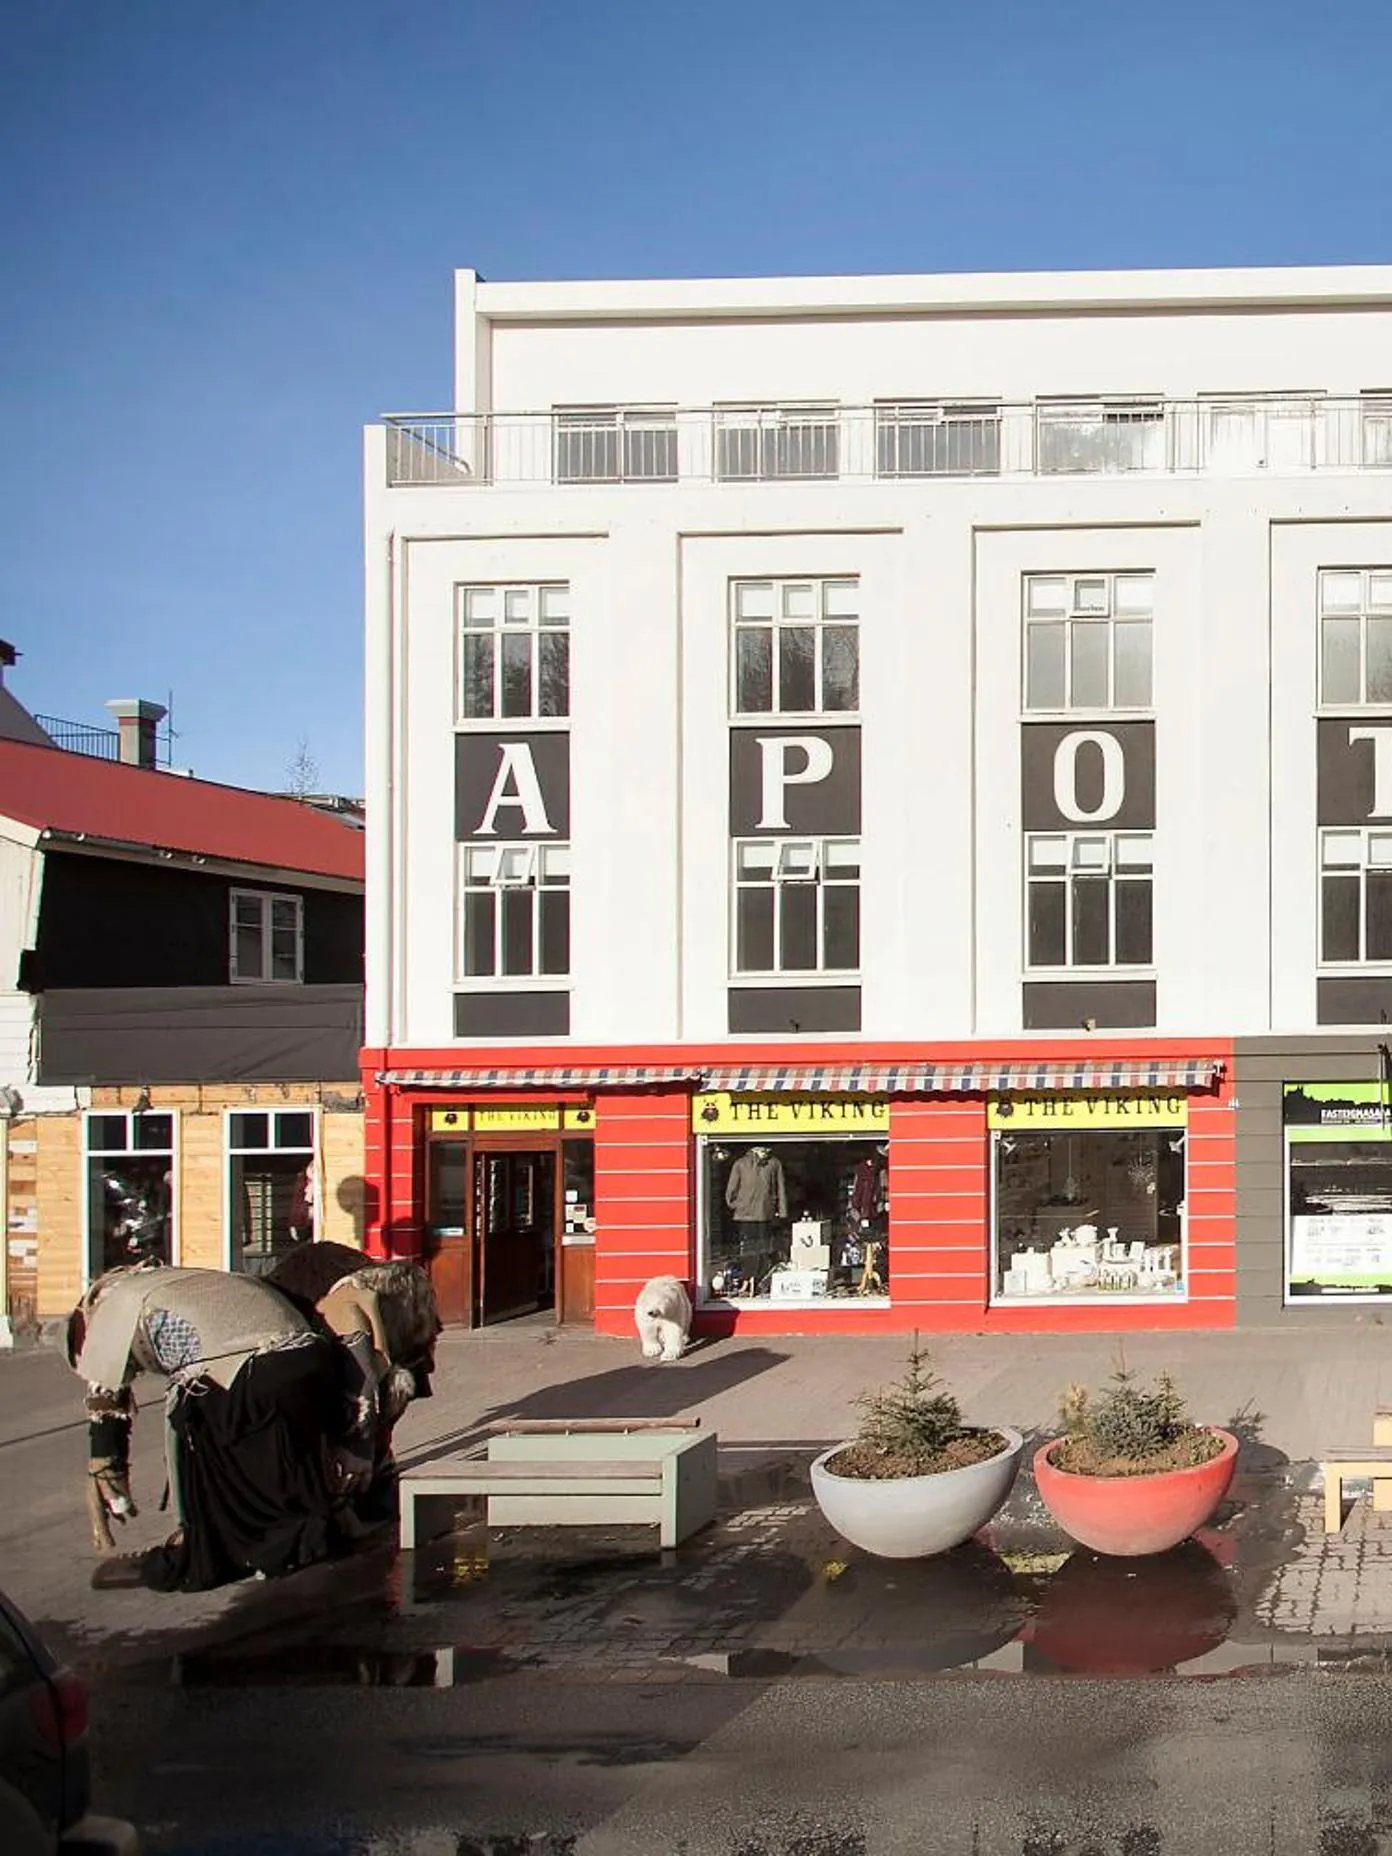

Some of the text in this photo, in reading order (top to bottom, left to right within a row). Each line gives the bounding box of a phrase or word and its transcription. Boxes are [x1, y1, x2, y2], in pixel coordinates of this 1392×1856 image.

[730, 1099, 886, 1121] THE VIKING
[1023, 1095, 1182, 1117] THE VIKING
